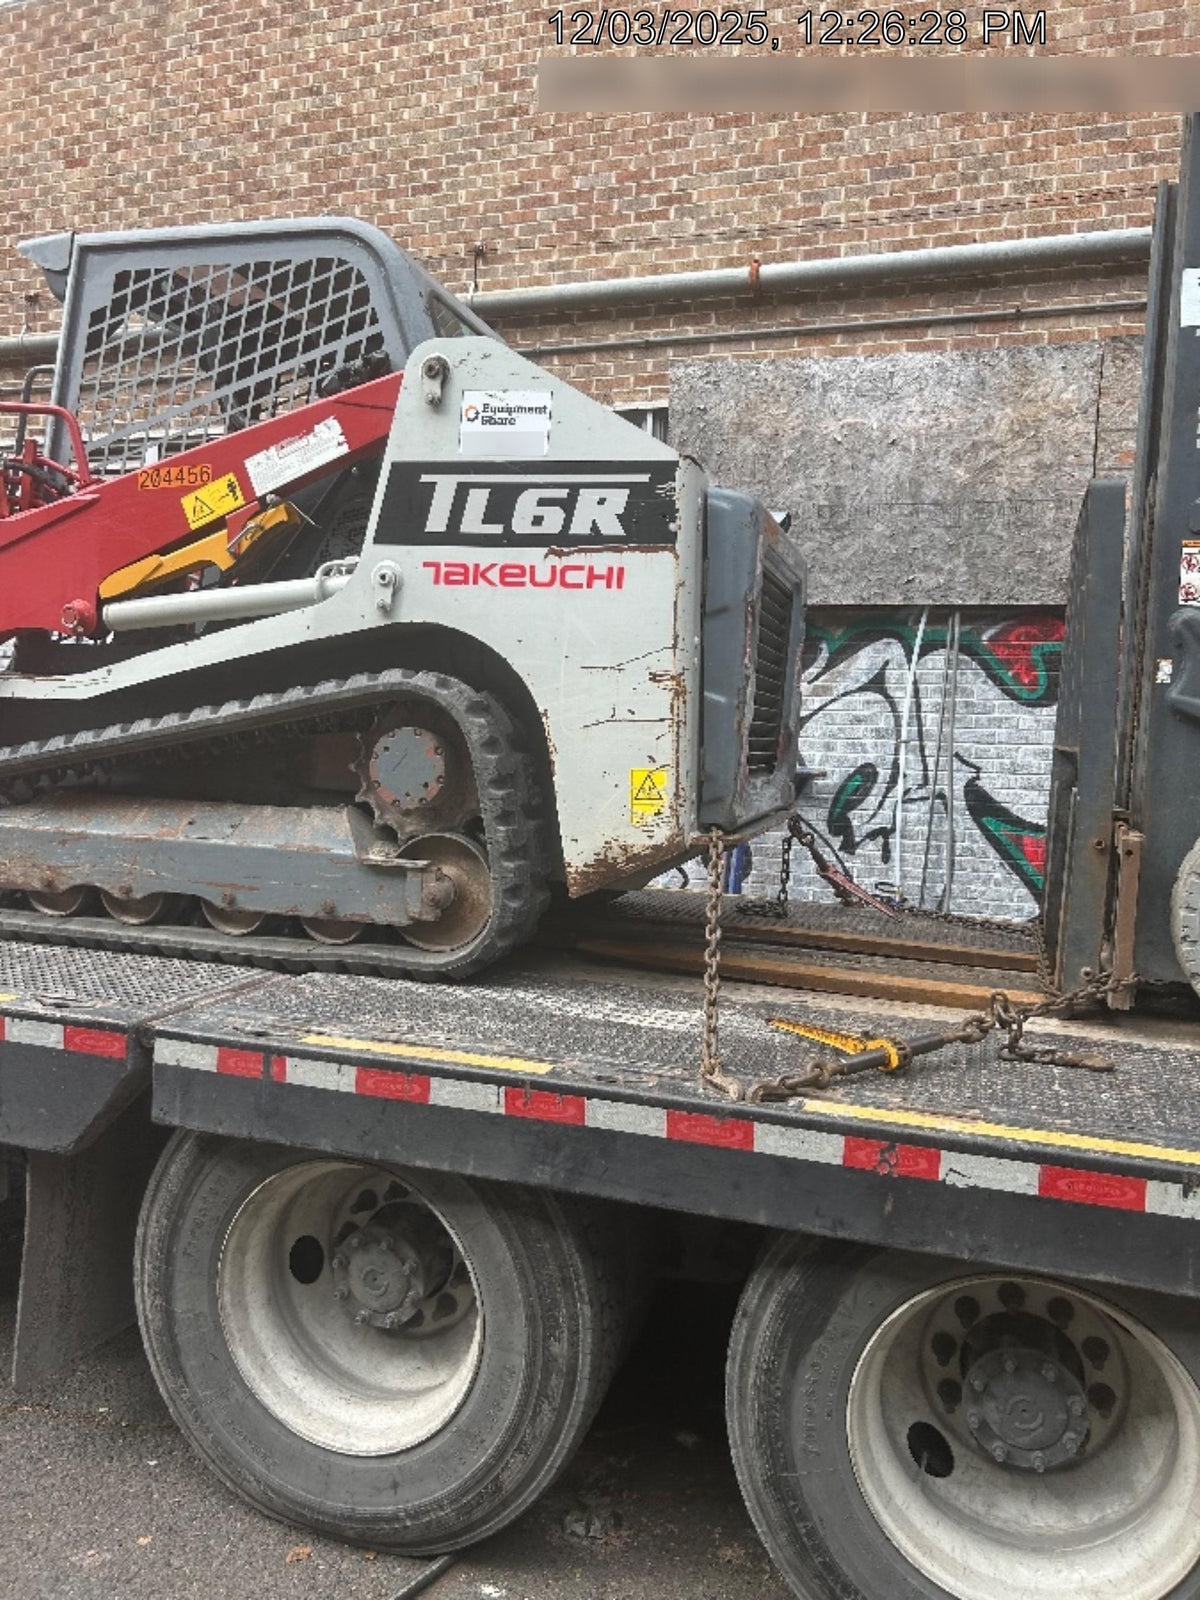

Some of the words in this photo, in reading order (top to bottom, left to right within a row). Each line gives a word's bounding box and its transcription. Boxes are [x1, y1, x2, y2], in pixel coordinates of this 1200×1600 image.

[481, 402, 549, 417] Equipment
[139, 465, 211, 488] 204456
[419, 474, 652, 536] TL6R
